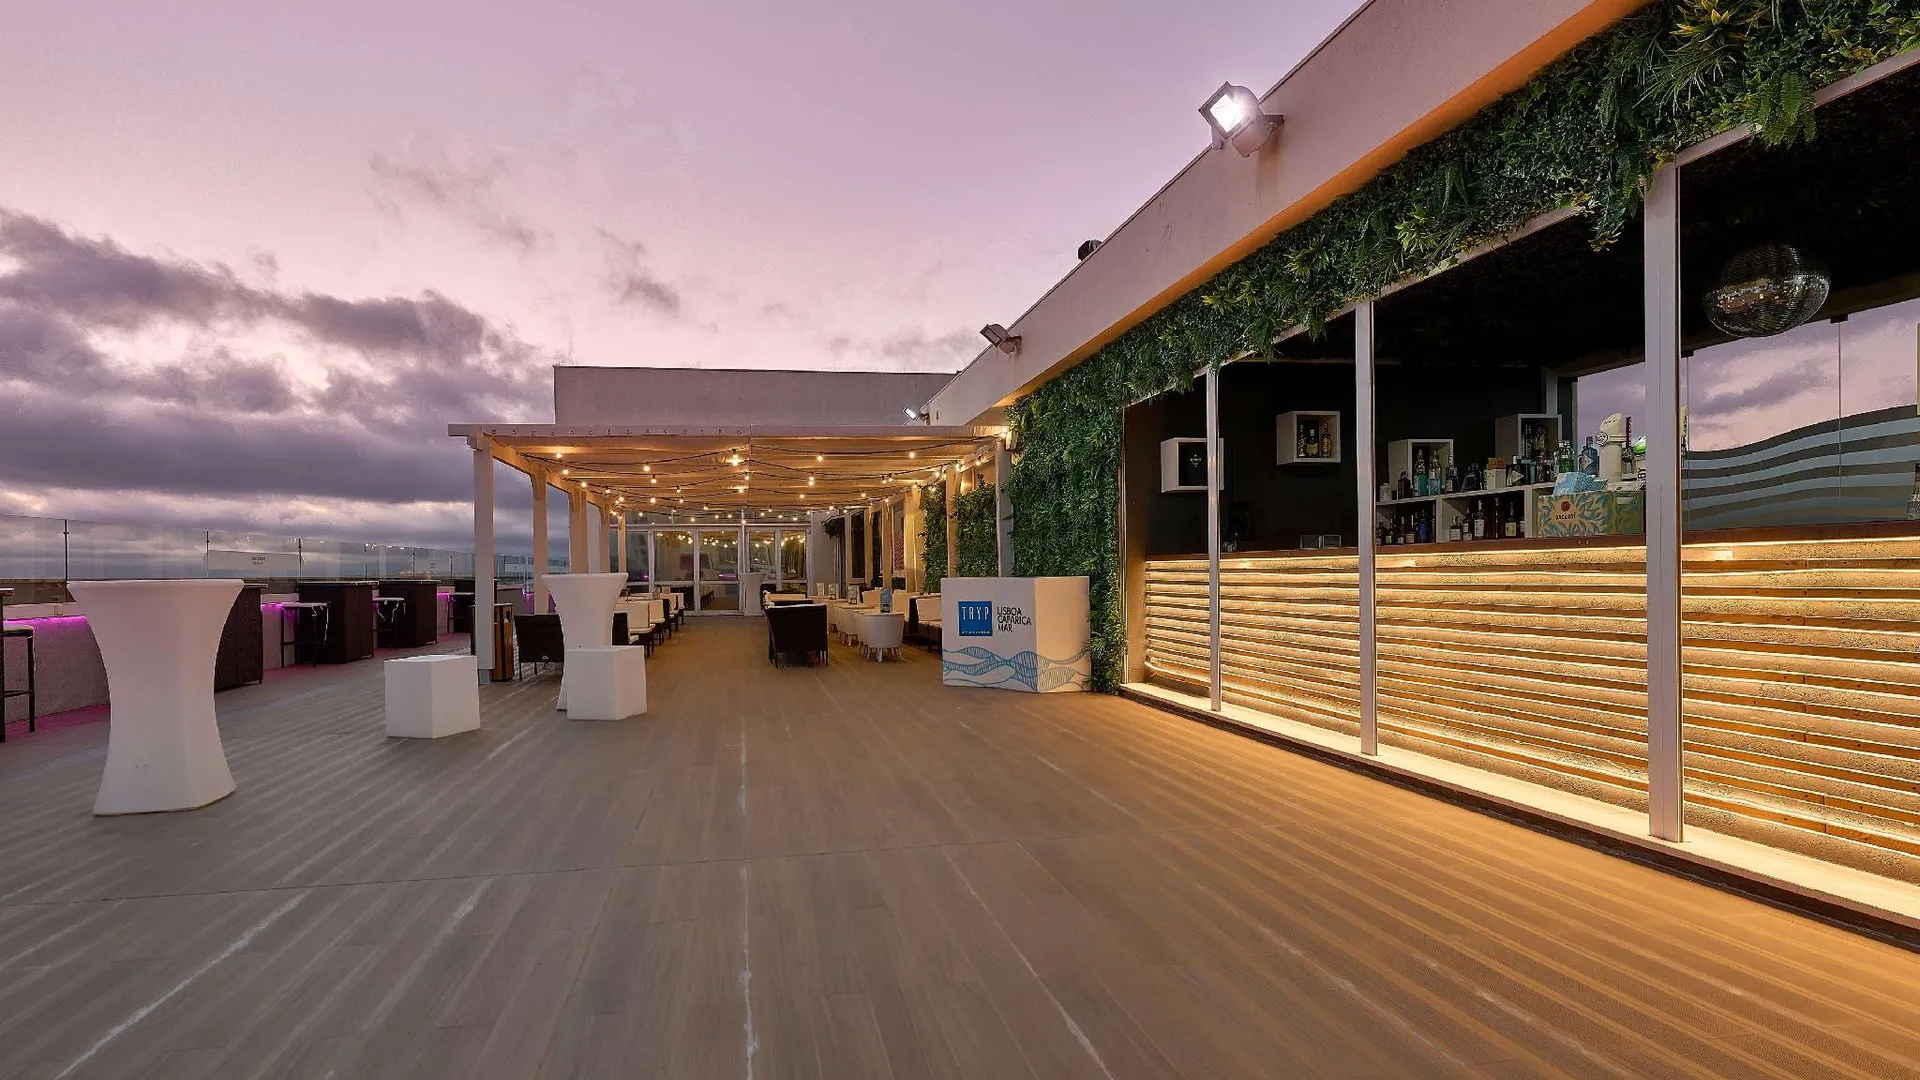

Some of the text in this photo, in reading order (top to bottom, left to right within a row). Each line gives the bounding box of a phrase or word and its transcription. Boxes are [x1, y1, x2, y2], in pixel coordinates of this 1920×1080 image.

[961, 606, 989, 620] TRYP
[997, 606, 1022, 616] LISBOA
[997, 615, 1032, 625] CAPARICA
[997, 624, 1013, 632] MAR
